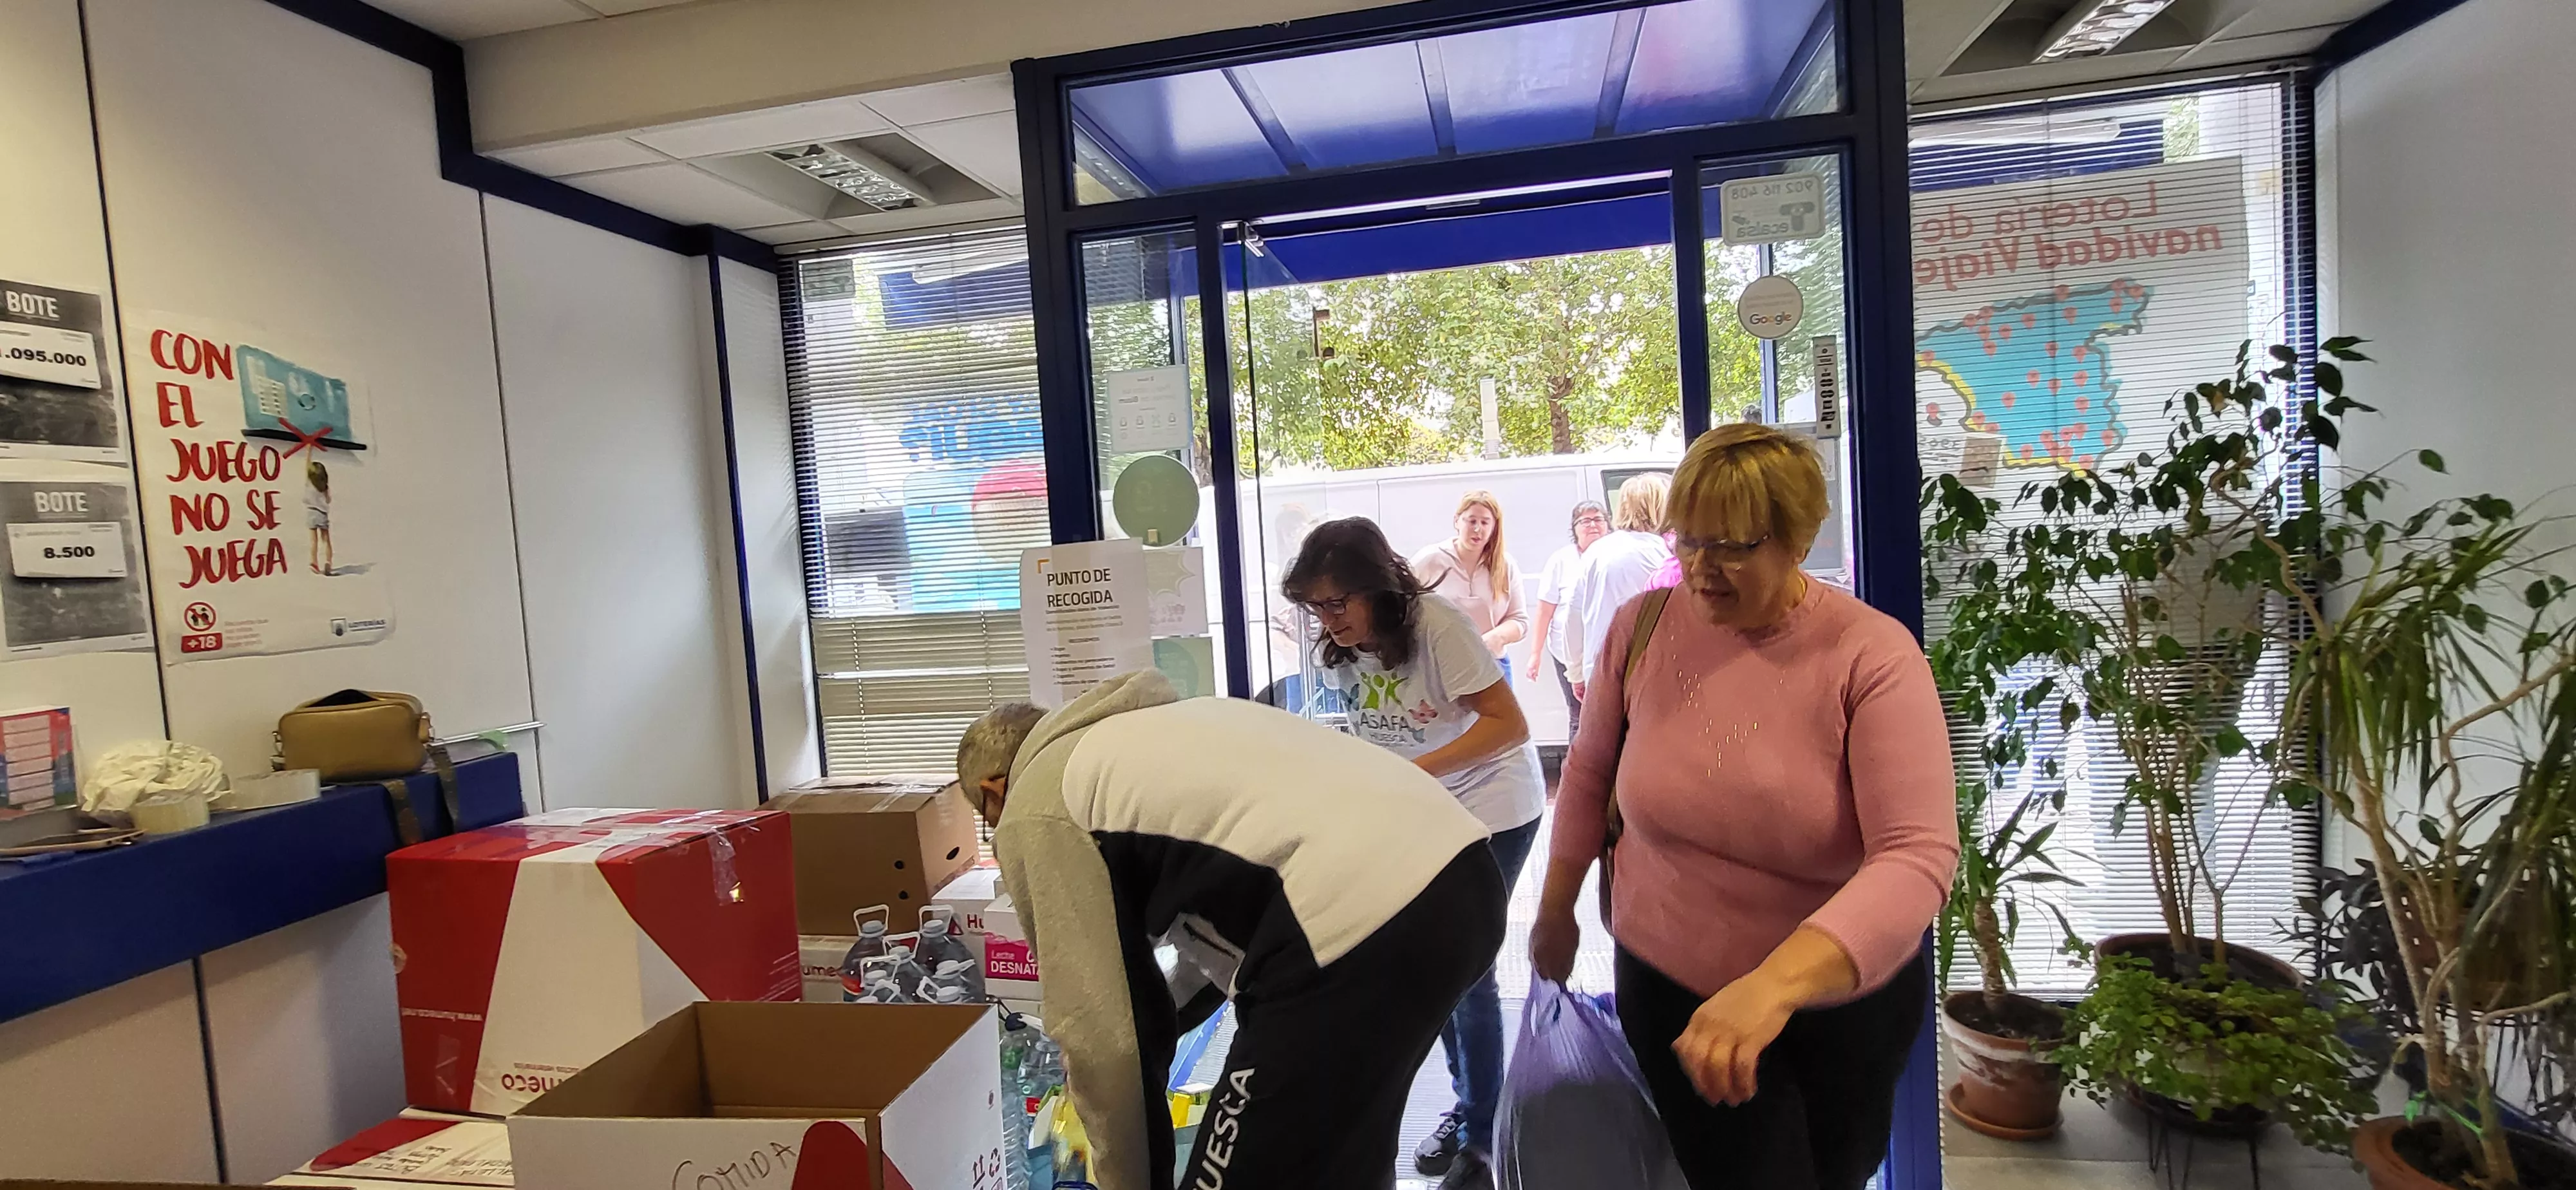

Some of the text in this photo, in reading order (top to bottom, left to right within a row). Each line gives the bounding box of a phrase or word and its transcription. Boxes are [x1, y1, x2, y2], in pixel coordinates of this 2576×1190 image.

[5, 290, 60, 318] BOTE
[1749, 311, 1792, 326] Google
[0, 346, 87, 367] .095.000
[150, 328, 234, 381] CON
[156, 381, 204, 428] EL
[166, 438, 282, 483] JUEGO
[33, 491, 90, 513] BOTE
[169, 490, 282, 536] NO SE
[43, 546, 95, 559] 8.500
[178, 538, 288, 589] JUEGA
[1046, 568, 1112, 587] PUNTO DE
[1046, 589, 1113, 608] RECOGIDA
[187, 635, 217, 649] +18
[1360, 712, 1409, 732] ASAFA
[990, 960, 1039, 976] DESNAT
[1193, 1068, 1255, 1190] UESCA
